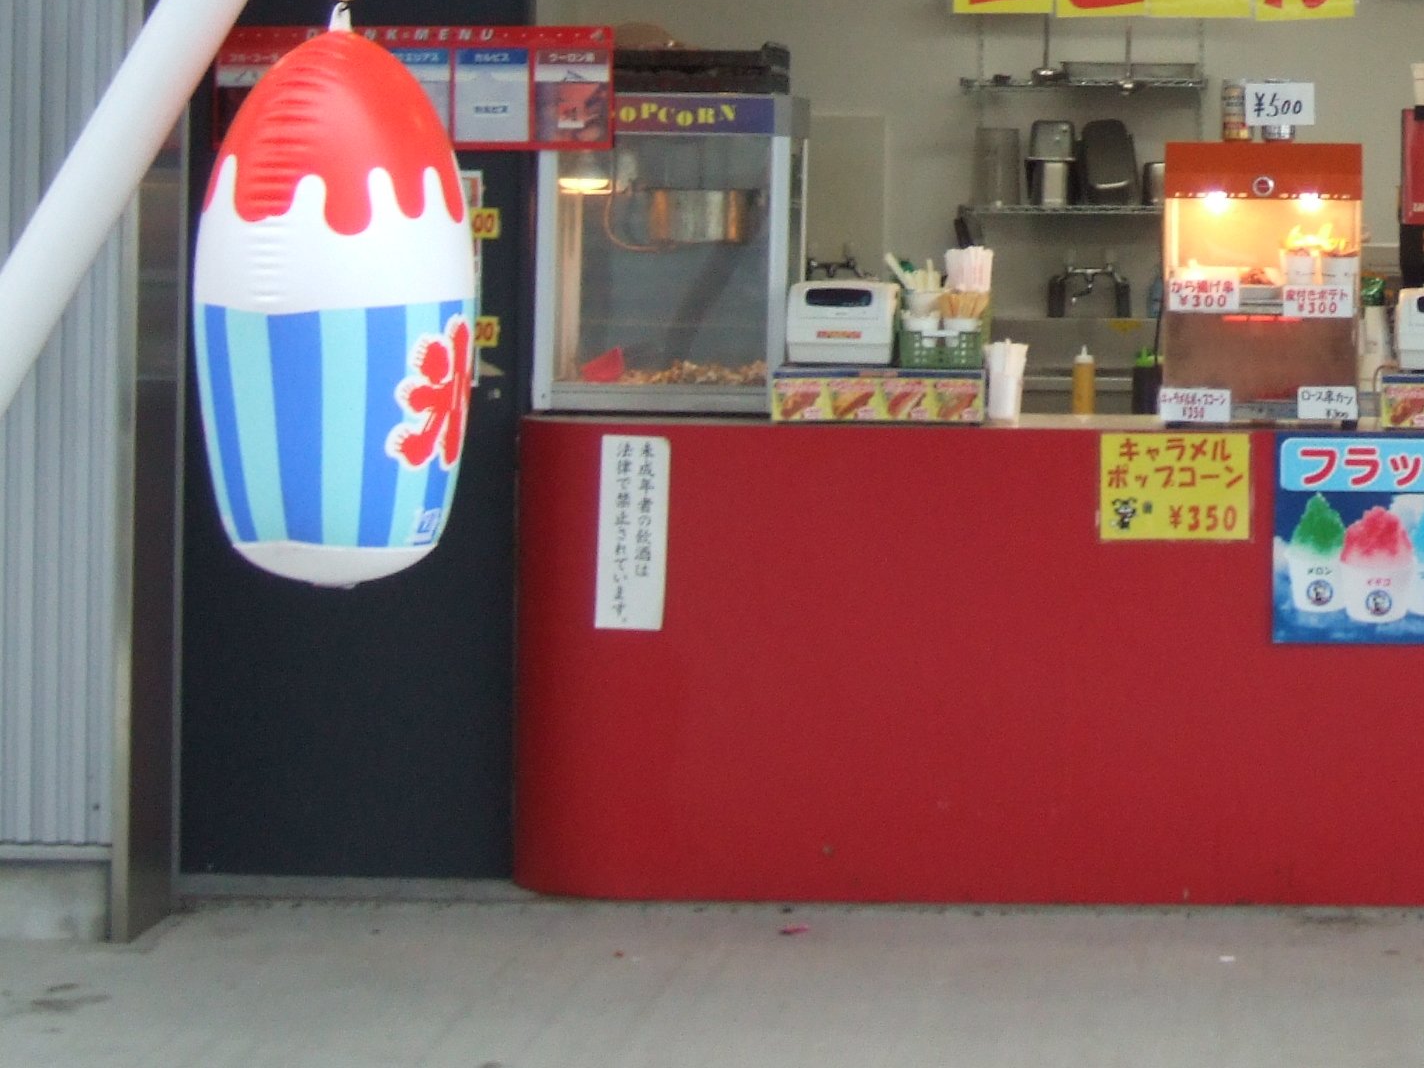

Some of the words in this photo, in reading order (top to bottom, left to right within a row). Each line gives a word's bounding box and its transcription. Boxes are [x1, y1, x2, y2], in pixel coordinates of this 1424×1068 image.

[612, 101, 738, 127] OPCORN
[1254, 92, 1303, 117] ¥500
[1178, 294, 1227, 308] ¥300
[1298, 302, 1338, 314] ¥300
[1119, 438, 1231, 463] キャラメル
[1107, 465, 1244, 490] ポップコーン
[1169, 504, 1237, 531] ¥350
